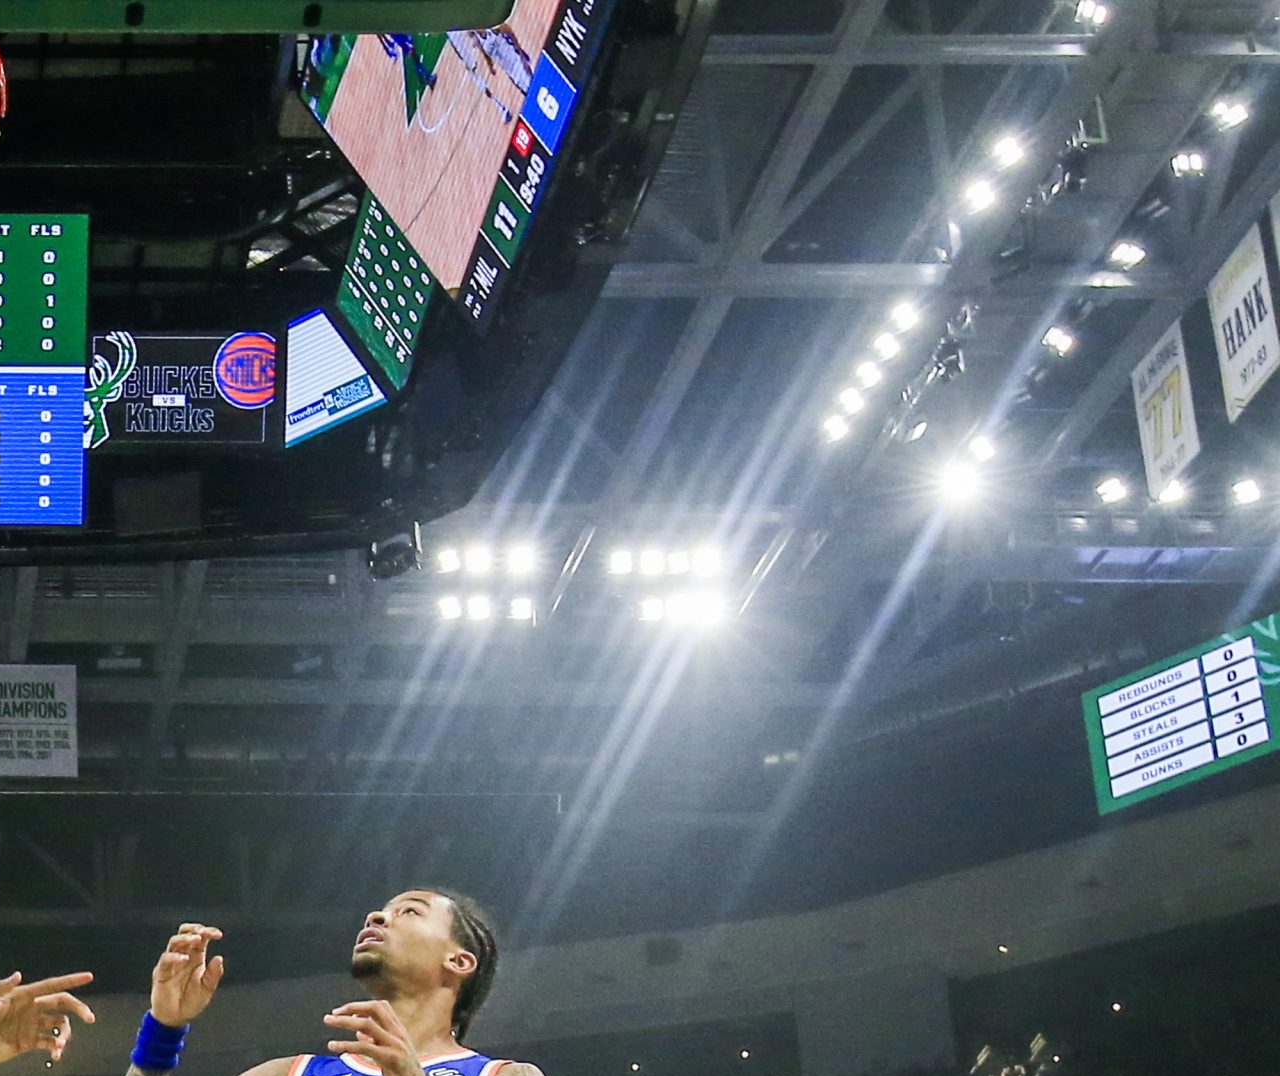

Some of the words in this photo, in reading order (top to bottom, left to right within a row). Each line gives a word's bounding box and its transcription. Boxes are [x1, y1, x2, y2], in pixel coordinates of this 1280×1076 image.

[555, 8, 587, 65] NYK
[536, 86, 560, 121] 6
[519, 152, 545, 205] 9:40
[30, 224, 62, 236] FLS
[493, 201, 518, 241] 11
[43, 251, 55, 263] 0
[42, 273, 55, 285] 0
[473, 256, 498, 295] MIL
[46, 295, 54, 307] 1
[42, 317, 54, 329] 0
[1221, 276, 1268, 360] HANK
[41, 338, 53, 350] 0
[27, 384, 58, 396] FLS
[124, 366, 216, 399] BUCKS
[40, 410, 52, 423] 0
[125, 403, 215, 433] Knicks
[39, 431, 52, 444] 0
[39, 453, 51, 465] 0
[39, 474, 51, 487] 0
[38, 496, 50, 508] 0
[1118, 670, 1183, 704] REBOUNDS
[1223, 649, 1233, 661] 0
[1130, 695, 1176, 720] BLOCKS
[1227, 670, 1237, 682] 0
[1133, 716, 1178, 741] STEALS
[1230, 691, 1240, 703] 1
[1134, 736, 1183, 762] ASSISTS
[1235, 712, 1244, 725] 3
[1141, 759, 1183, 782] DUNKS
[1237, 734, 1247, 746] 0
